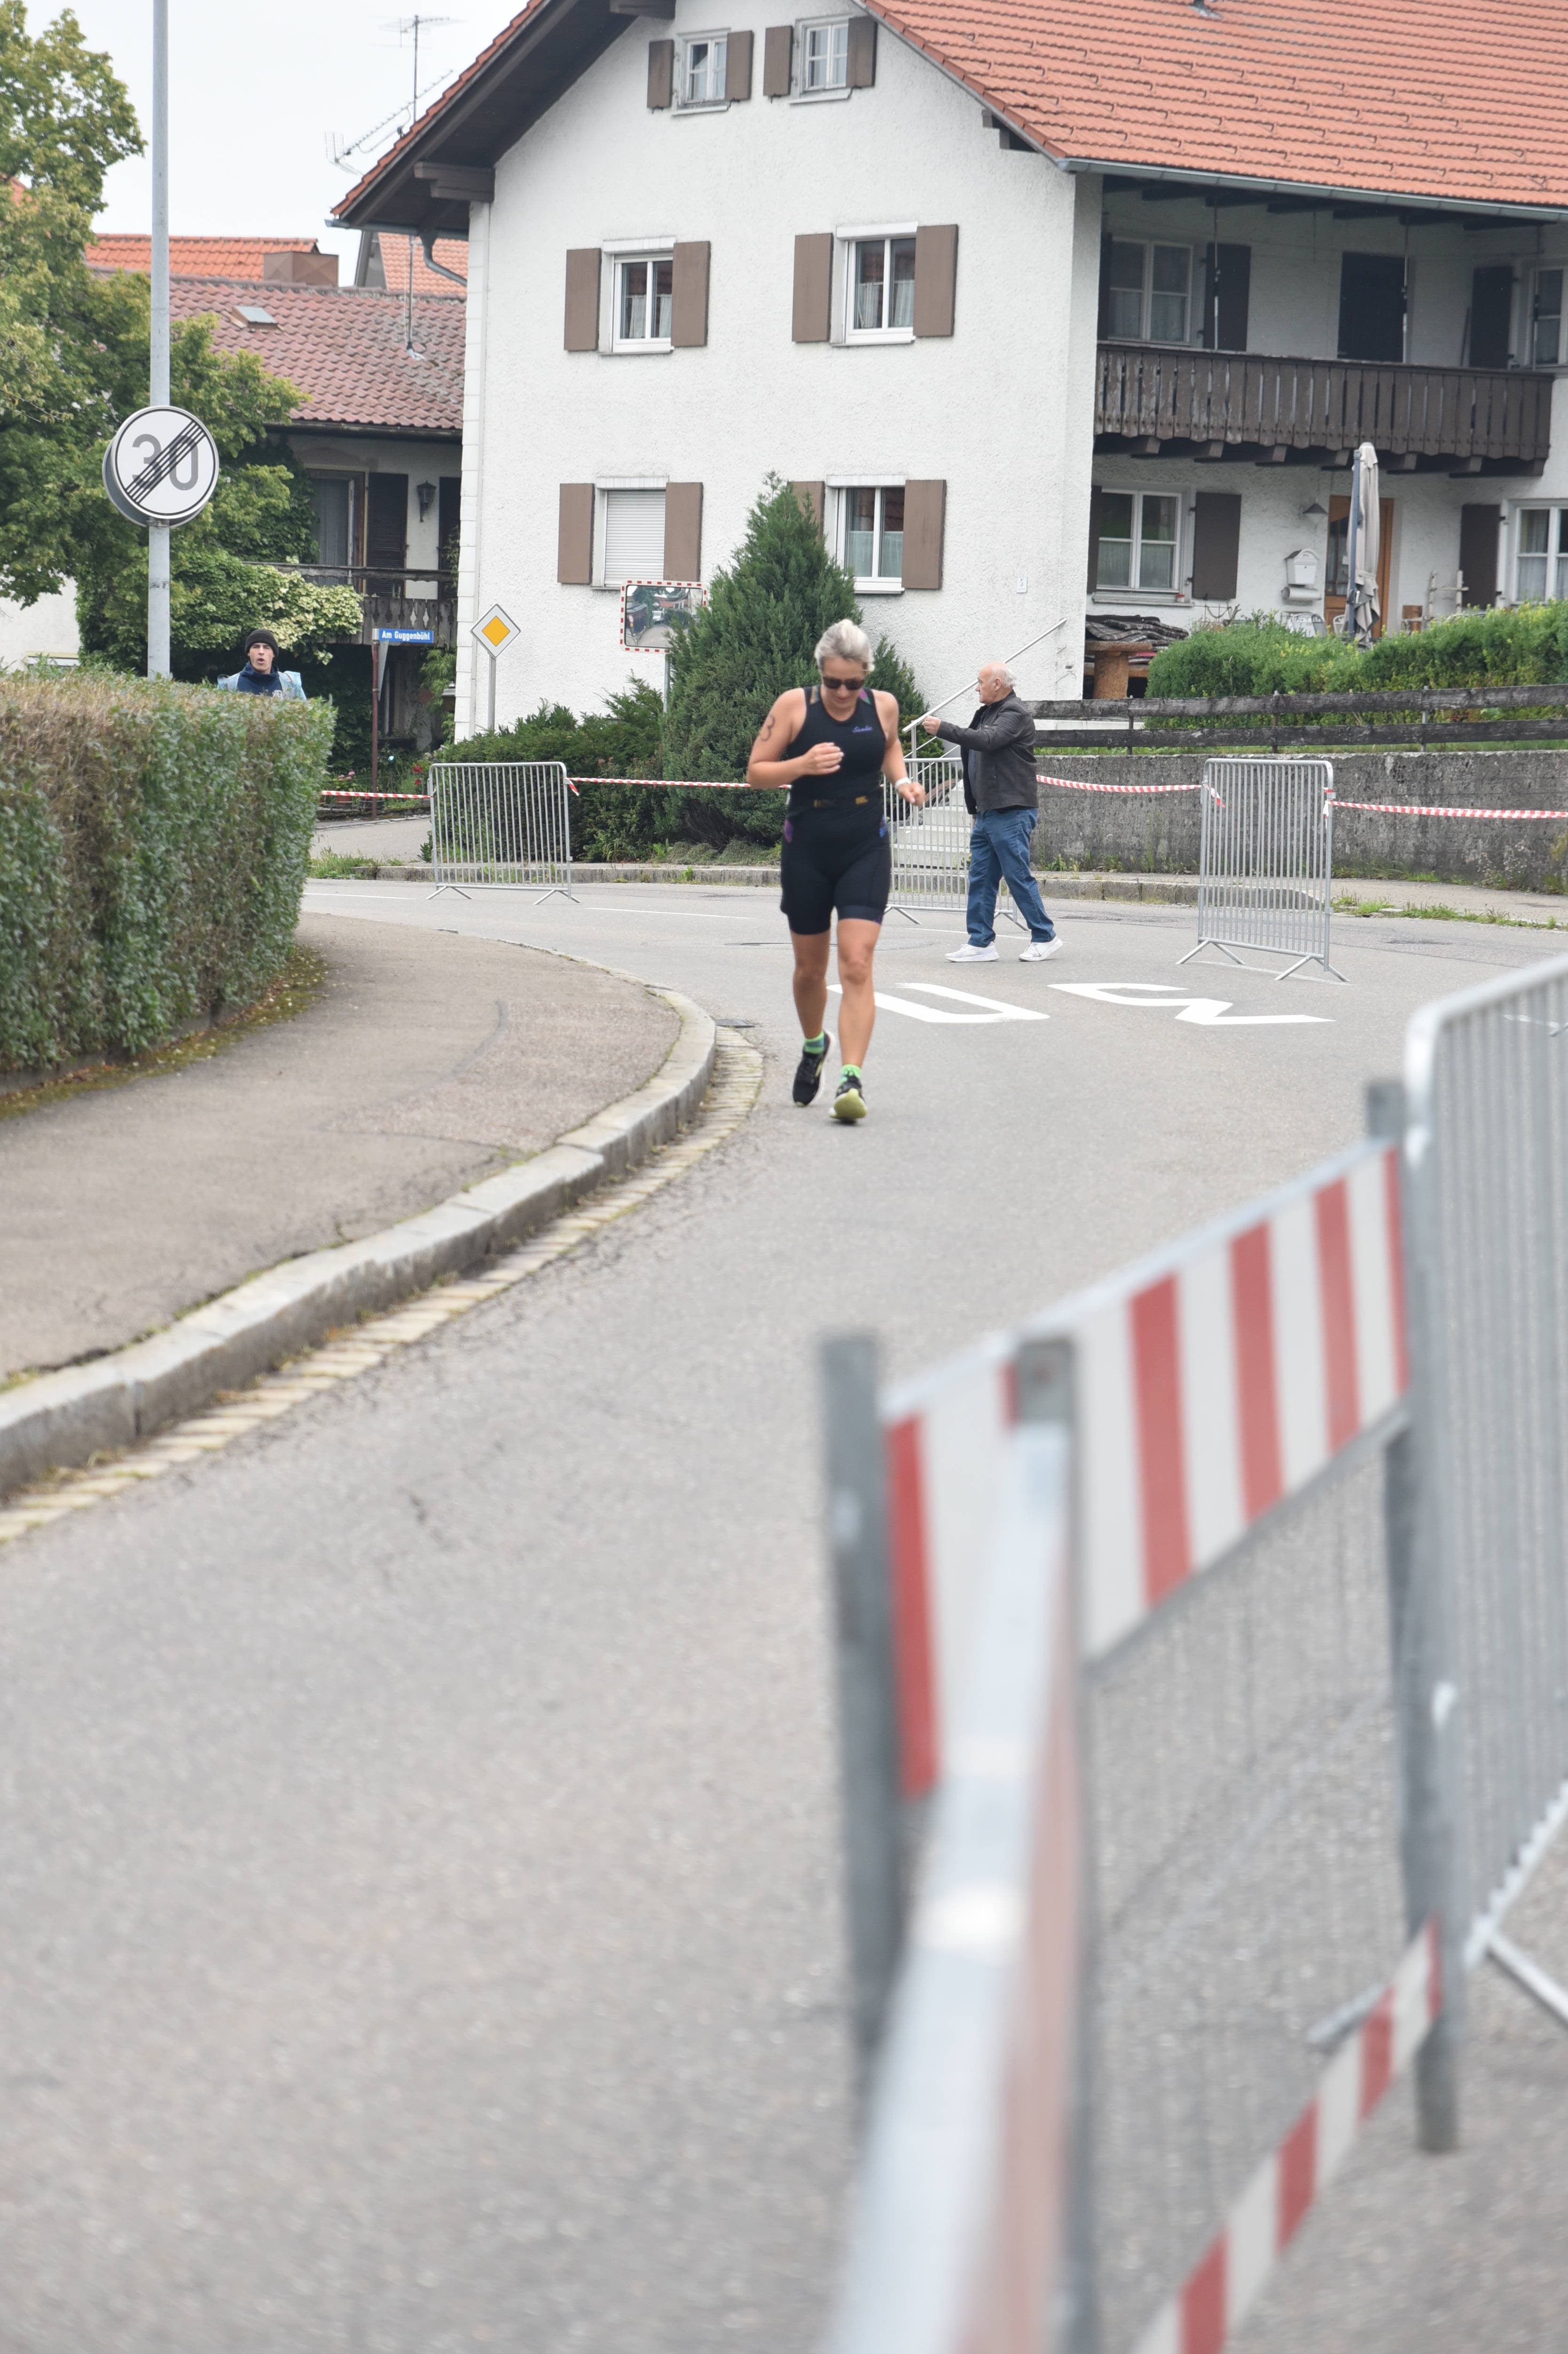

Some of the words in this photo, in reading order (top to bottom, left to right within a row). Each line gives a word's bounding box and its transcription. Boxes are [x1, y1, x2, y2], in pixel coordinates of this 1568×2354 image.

[132, 433, 198, 491] 30
[382, 630, 392, 639] Am
[394, 631, 430, 641] Guggenbühl
